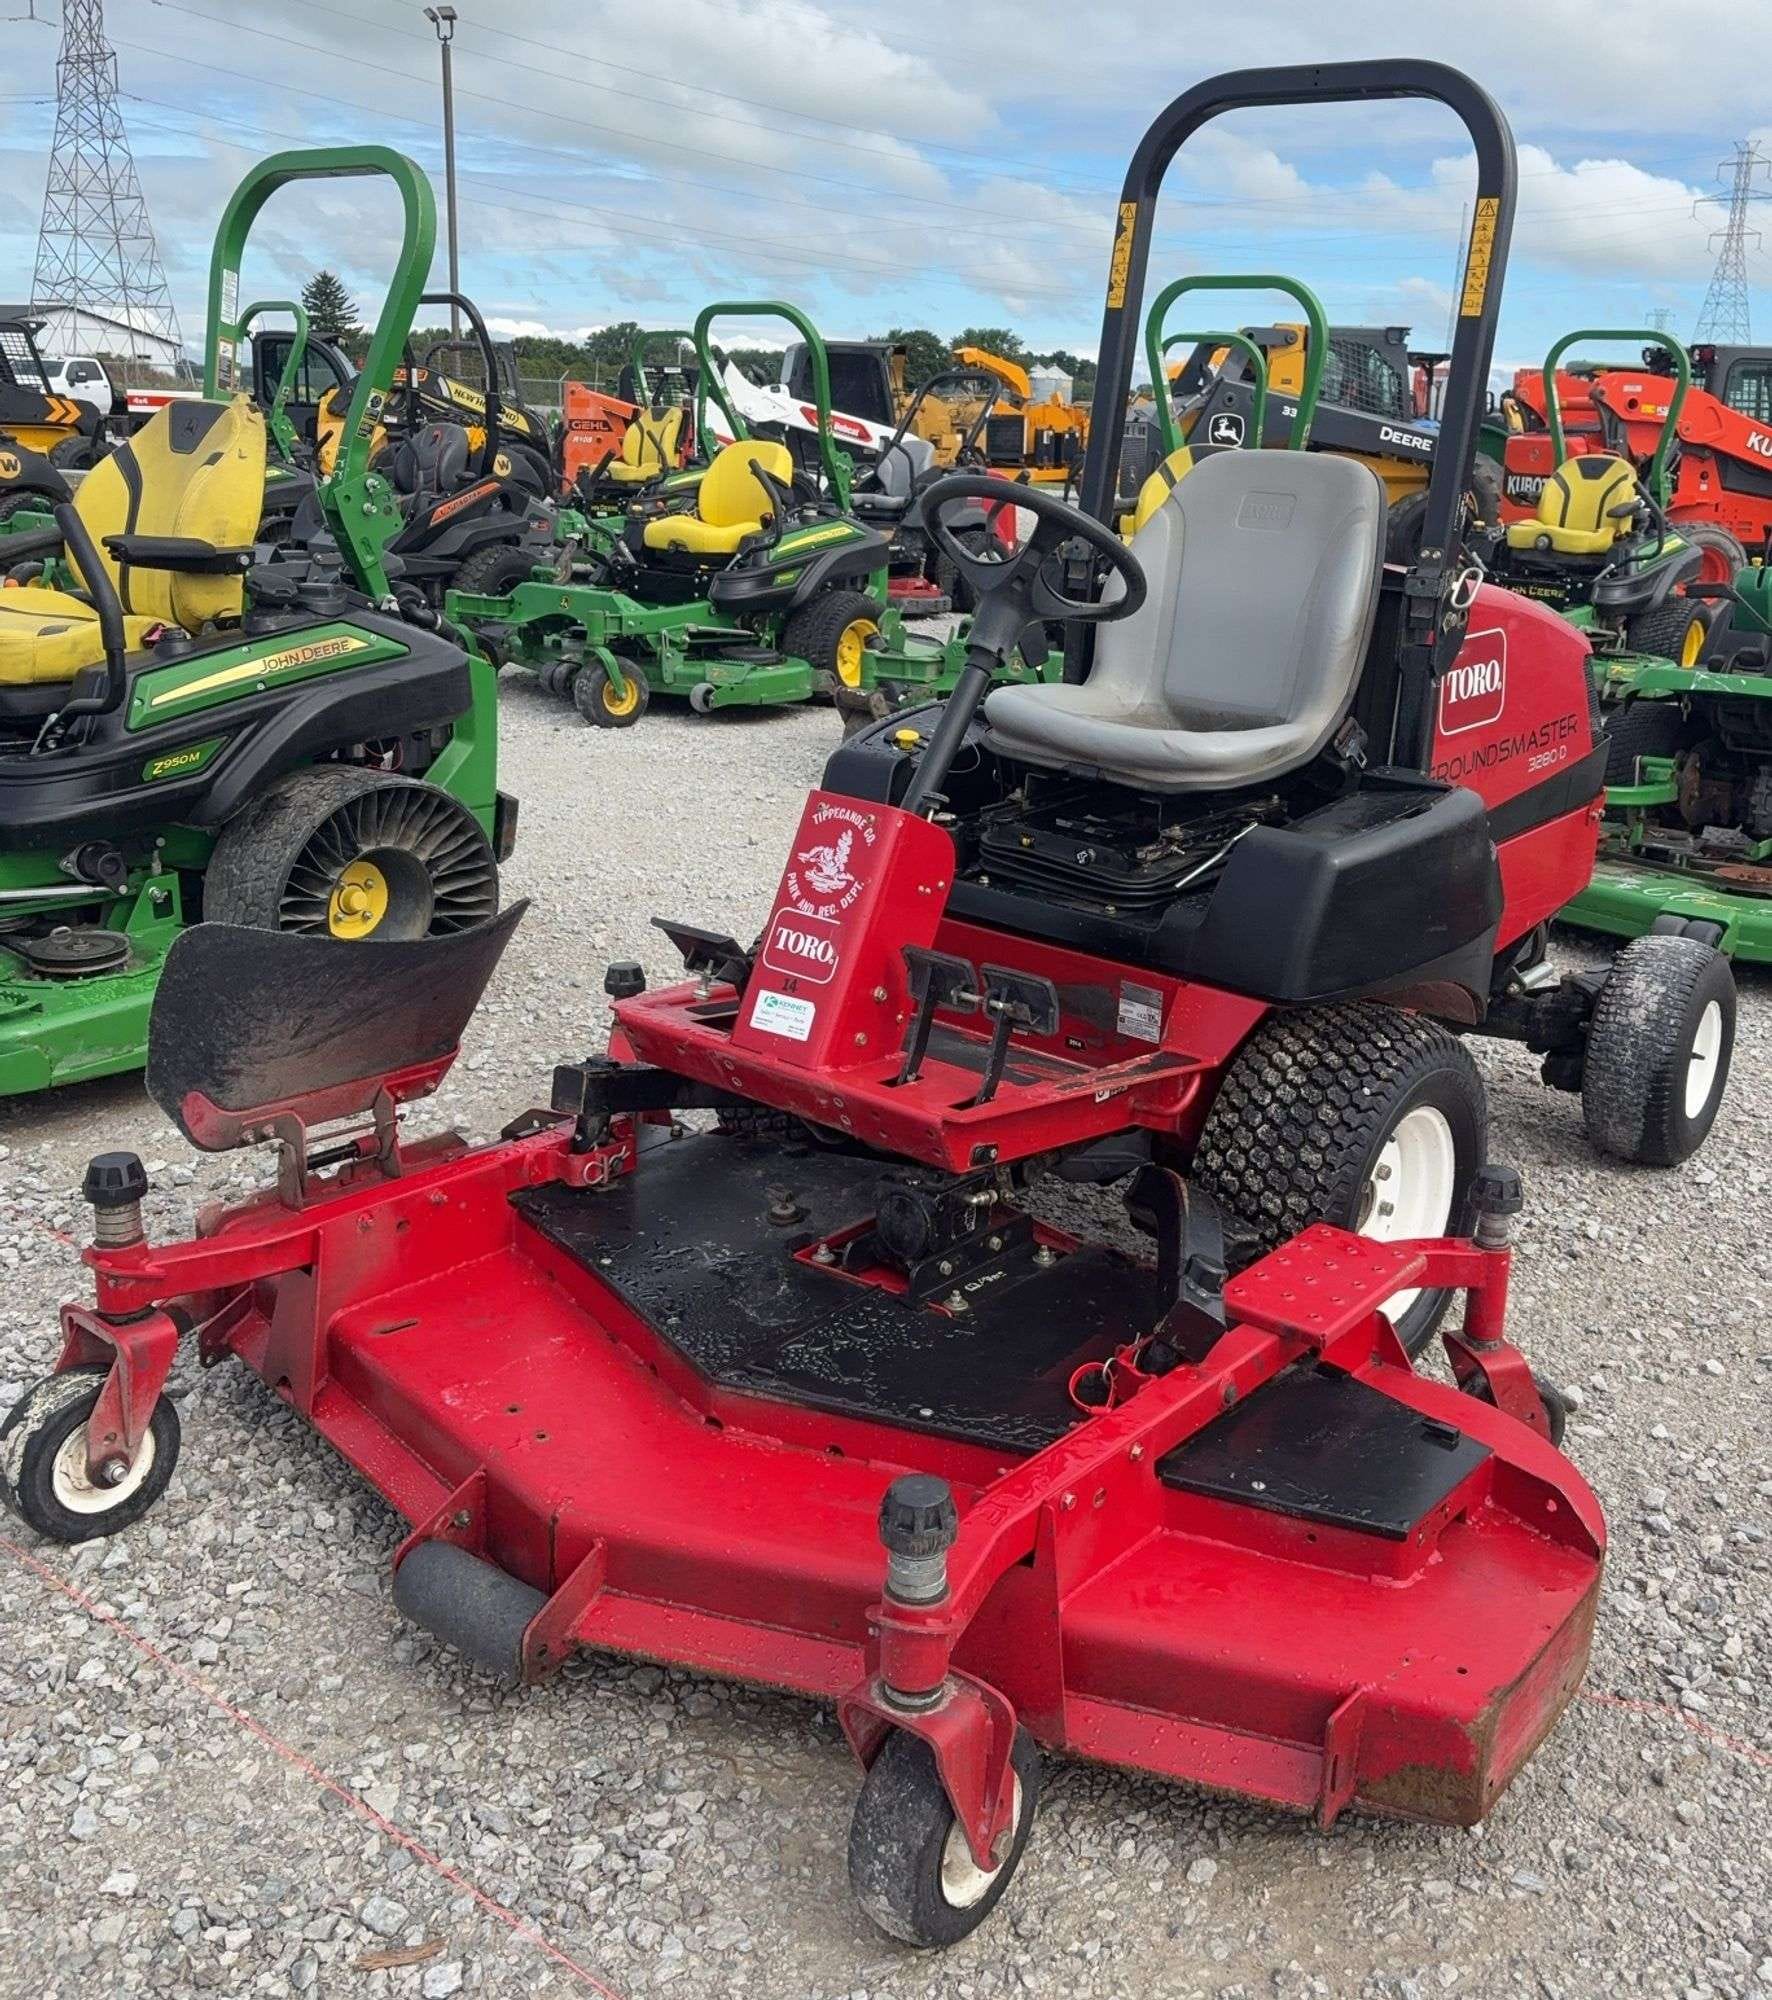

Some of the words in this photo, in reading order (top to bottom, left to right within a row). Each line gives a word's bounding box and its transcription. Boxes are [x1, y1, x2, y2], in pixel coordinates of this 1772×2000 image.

[132, 397, 148, 405] 4x4
[571, 420, 609, 430] GEHL
[1379, 426, 1433, 451] DEERE
[259, 654, 300, 674] JOHN
[300, 639, 350, 664] DEERE
[1447, 659, 1500, 704] TORO
[152, 752, 200, 774] Z950M
[1528, 751, 1557, 773] 3280
[1559, 745, 1567, 759] D
[812, 807, 868, 830] TIPPECANOE
[787, 872, 801, 900] PARK
[797, 898, 815, 914] AND
[840, 881, 865, 909] DEPT.
[775, 927, 834, 963] TORO
